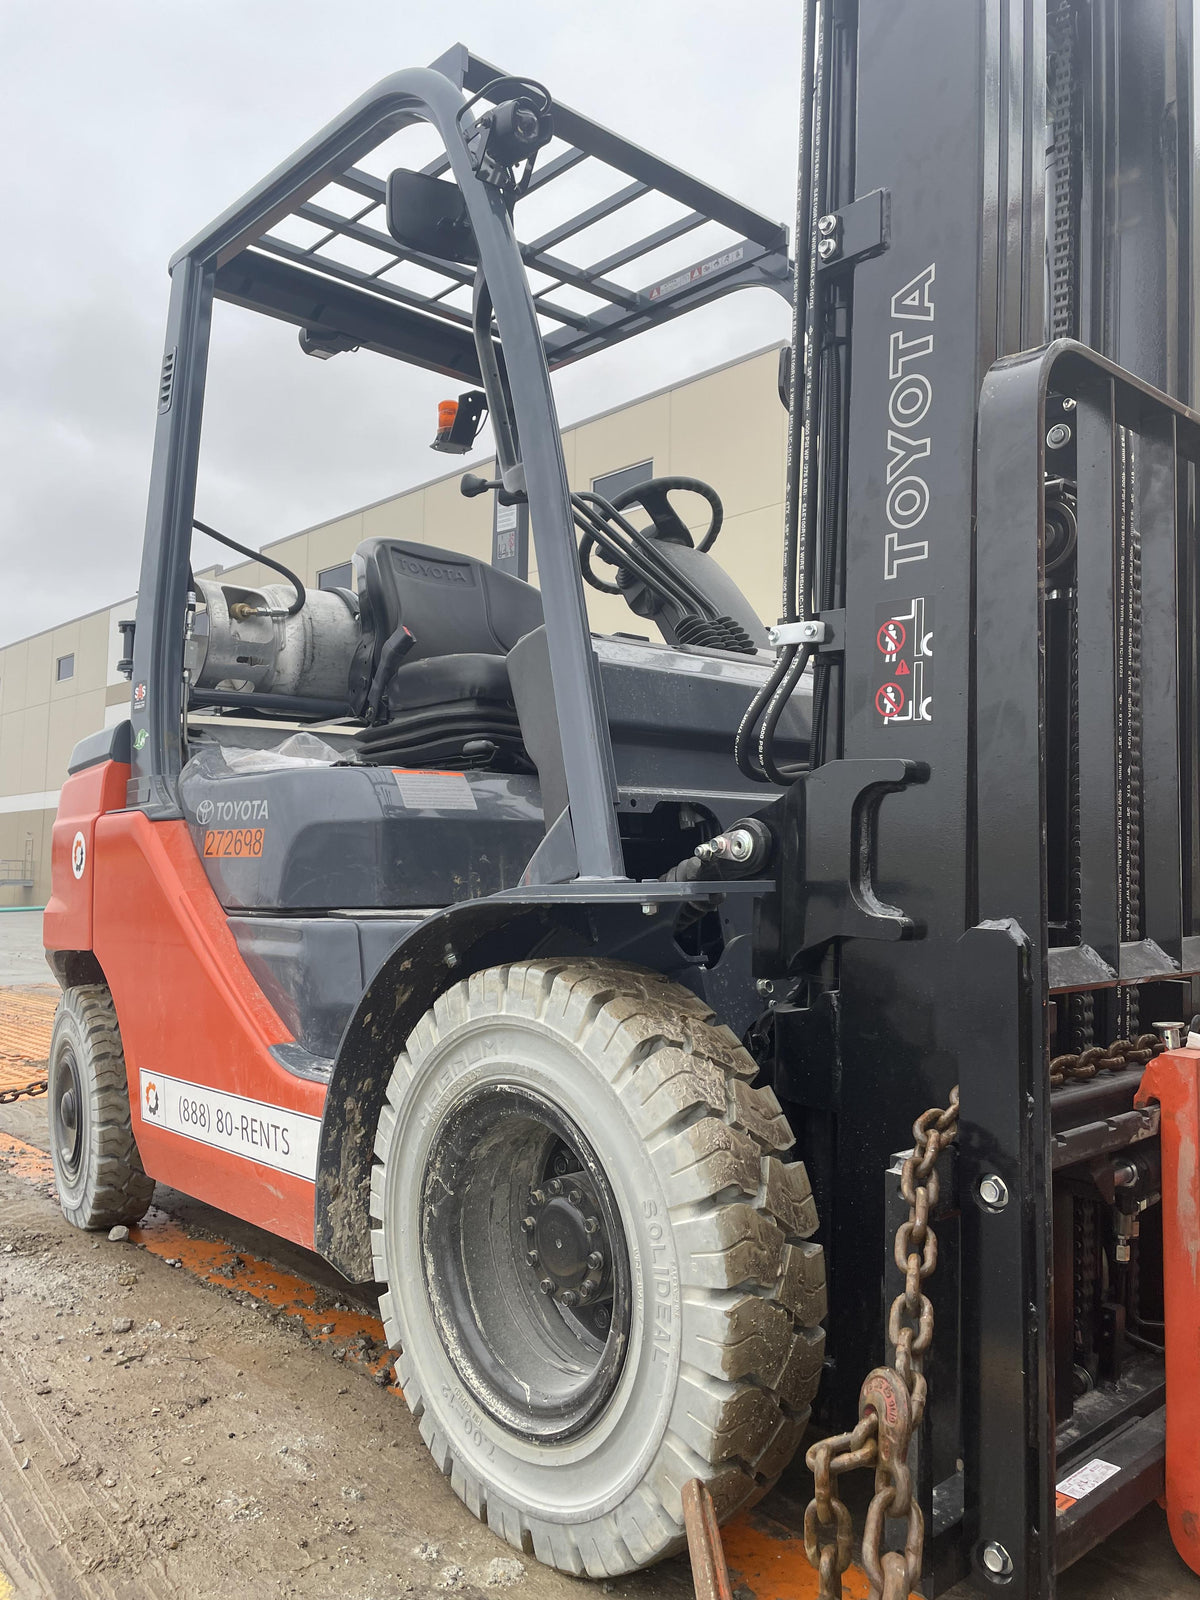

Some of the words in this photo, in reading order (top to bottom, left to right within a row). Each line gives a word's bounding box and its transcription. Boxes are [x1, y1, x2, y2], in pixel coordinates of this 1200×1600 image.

[884, 262, 936, 580] TOYOTA
[400, 558, 466, 583] TOYOTA
[758, 754, 764, 766] WP
[216, 799, 269, 821] TOYOTA
[205, 829, 263, 856] 272698
[178, 1095, 211, 1134] (888)
[216, 1108, 290, 1156] 80-RENTS
[642, 1199, 672, 1363] SOLIDEAL
[440, 1382, 496, 1464] 7.00-12
